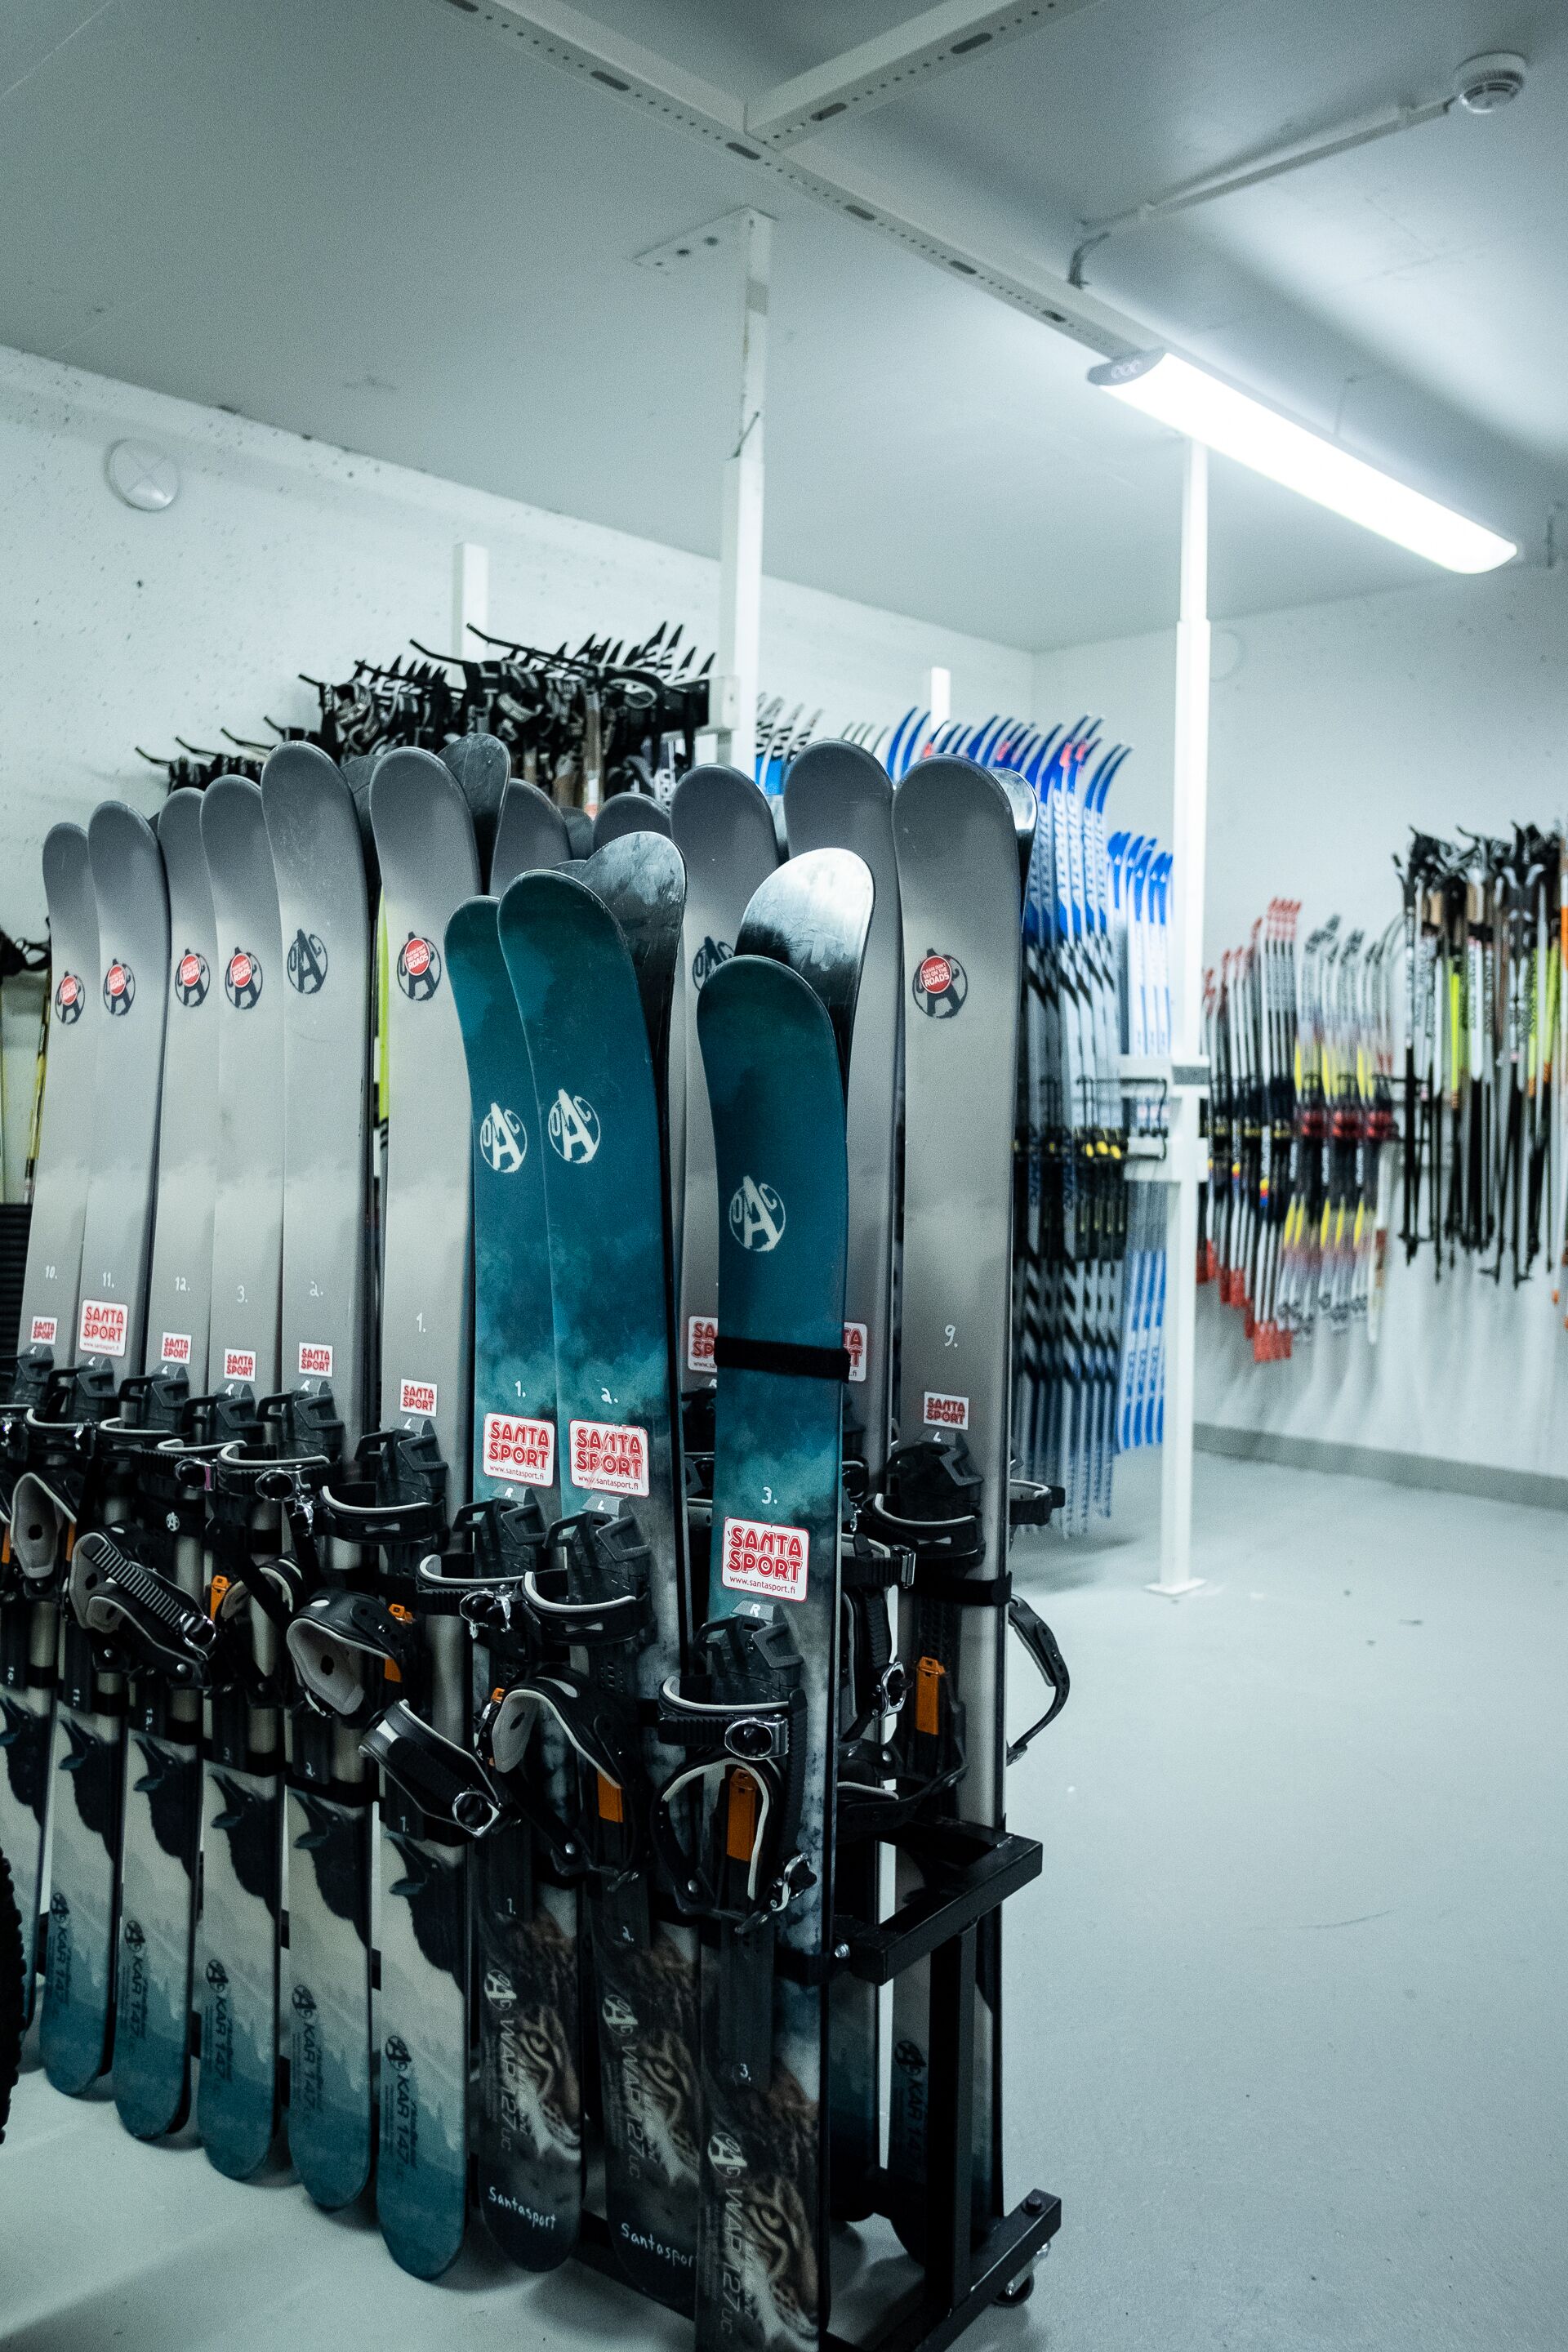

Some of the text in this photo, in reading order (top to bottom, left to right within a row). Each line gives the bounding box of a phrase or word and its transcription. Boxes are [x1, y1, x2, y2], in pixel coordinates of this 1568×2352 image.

[924, 972, 950, 987] ROADS
[175, 1276, 190, 1291] 12.
[237, 1285, 248, 1303] 3.
[85, 1306, 123, 1324] SANTA
[33, 1321, 55, 1331] SANTA
[33, 1330, 54, 1340] SPORT
[83, 1323, 123, 1343] SPORT
[164, 1337, 189, 1349] SANTA
[944, 1324, 958, 1348] 9.
[163, 1348, 188, 1359] SPORT
[227, 1353, 253, 1366] SANTA
[301, 1348, 330, 1361] SANTA
[226, 1364, 252, 1377] SPORT
[301, 1358, 330, 1372] SPORT
[403, 1384, 434, 1401] SANTA
[514, 1380, 526, 1397] 1.
[403, 1397, 434, 1411] SPORT
[927, 1396, 965, 1414] SANTA
[926, 1409, 965, 1425] SPORT
[488, 1419, 550, 1449] SANTA
[576, 1427, 644, 1457] SANTA
[488, 1440, 550, 1470] SPORT
[489, 1464, 545, 1481] www.santasport.fi
[575, 1449, 644, 1481] SPORT
[761, 1486, 778, 1504] 3.
[728, 1525, 804, 1561] SANTA
[727, 1548, 804, 1584] SPORT
[729, 1575, 795, 1594] www.santasport.fi
[749, 1603, 762, 1617] R
[397, 2074, 411, 2118] KAR
[488, 2186, 557, 2230] Santasport
[724, 2188, 744, 2252] WAP
[621, 2222, 697, 2267] Santaspor
